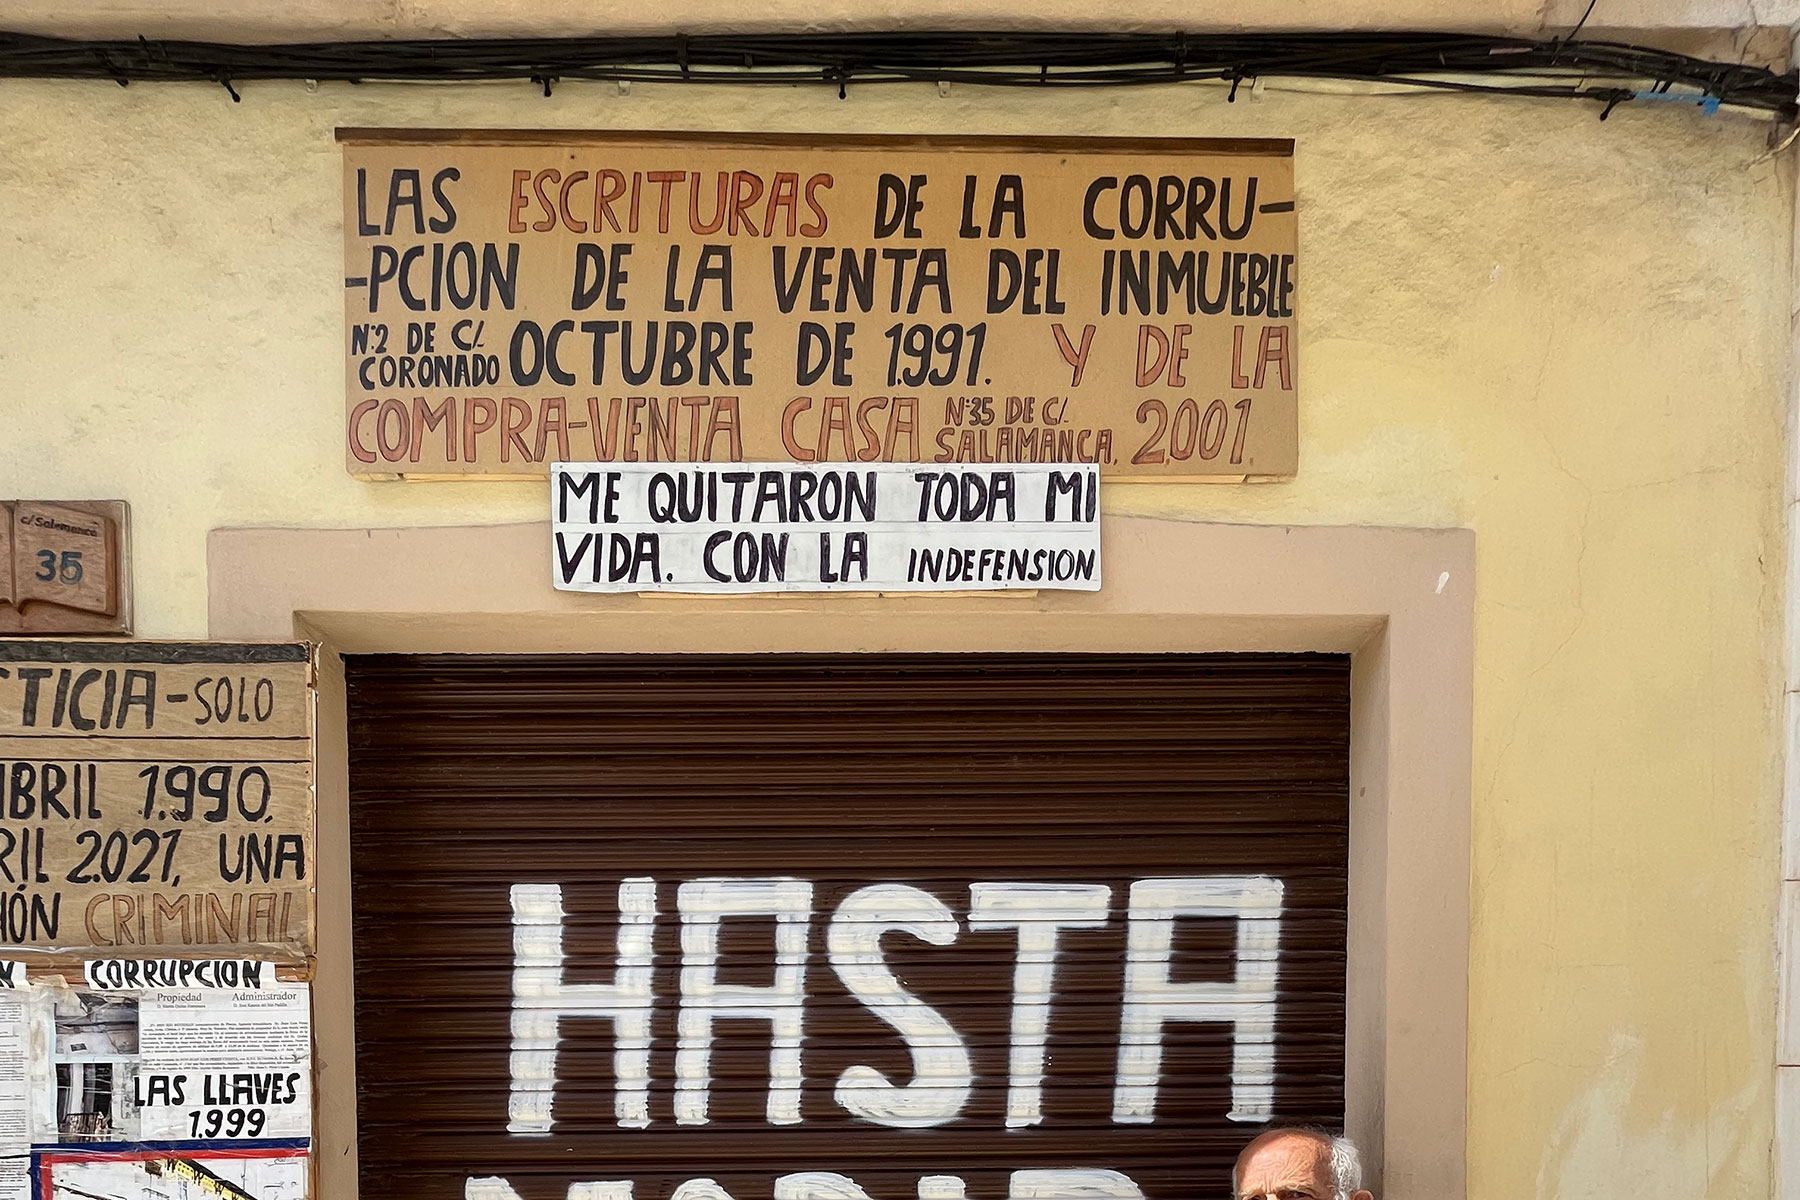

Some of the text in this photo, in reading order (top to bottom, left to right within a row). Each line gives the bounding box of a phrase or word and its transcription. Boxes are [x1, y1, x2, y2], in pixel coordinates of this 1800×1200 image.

[358, 167, 1295, 240] LAS ESCRITURAS DE LA CORRU-
[344, 243, 1295, 317] -PCION DE LA VENTA DEL INMUEBLE
[407, 322, 436, 354] DE
[509, 320, 753, 387] OCTUBRE
[797, 321, 855, 386] DE
[1051, 324, 1096, 387] Y
[1136, 324, 1192, 388] DE
[1231, 325, 1293, 391] LA
[359, 353, 500, 391] CORONADO
[349, 396, 921, 464] COMPRA-VENTA CASA
[1005, 396, 1035, 425] DE
[934, 427, 1118, 466] SALAMANCA,
[559, 471, 1096, 525] ME QUITARON TODA MI
[35, 549, 83, 585] 35
[556, 531, 1096, 584] VIDA. CON LA INDEFENSION
[0, 762, 102, 820] BRIL
[219, 833, 306, 884] UNA
[85, 892, 294, 946] CRIMINAL
[90, 960, 262, 989] CORRUPCION
[157, 992, 297, 1004] Propiedad Administrador
[506, 875, 1285, 1136] HASTA
[134, 1073, 300, 1107] LAS LLAVES
[189, 1108, 265, 1138] 1.999
